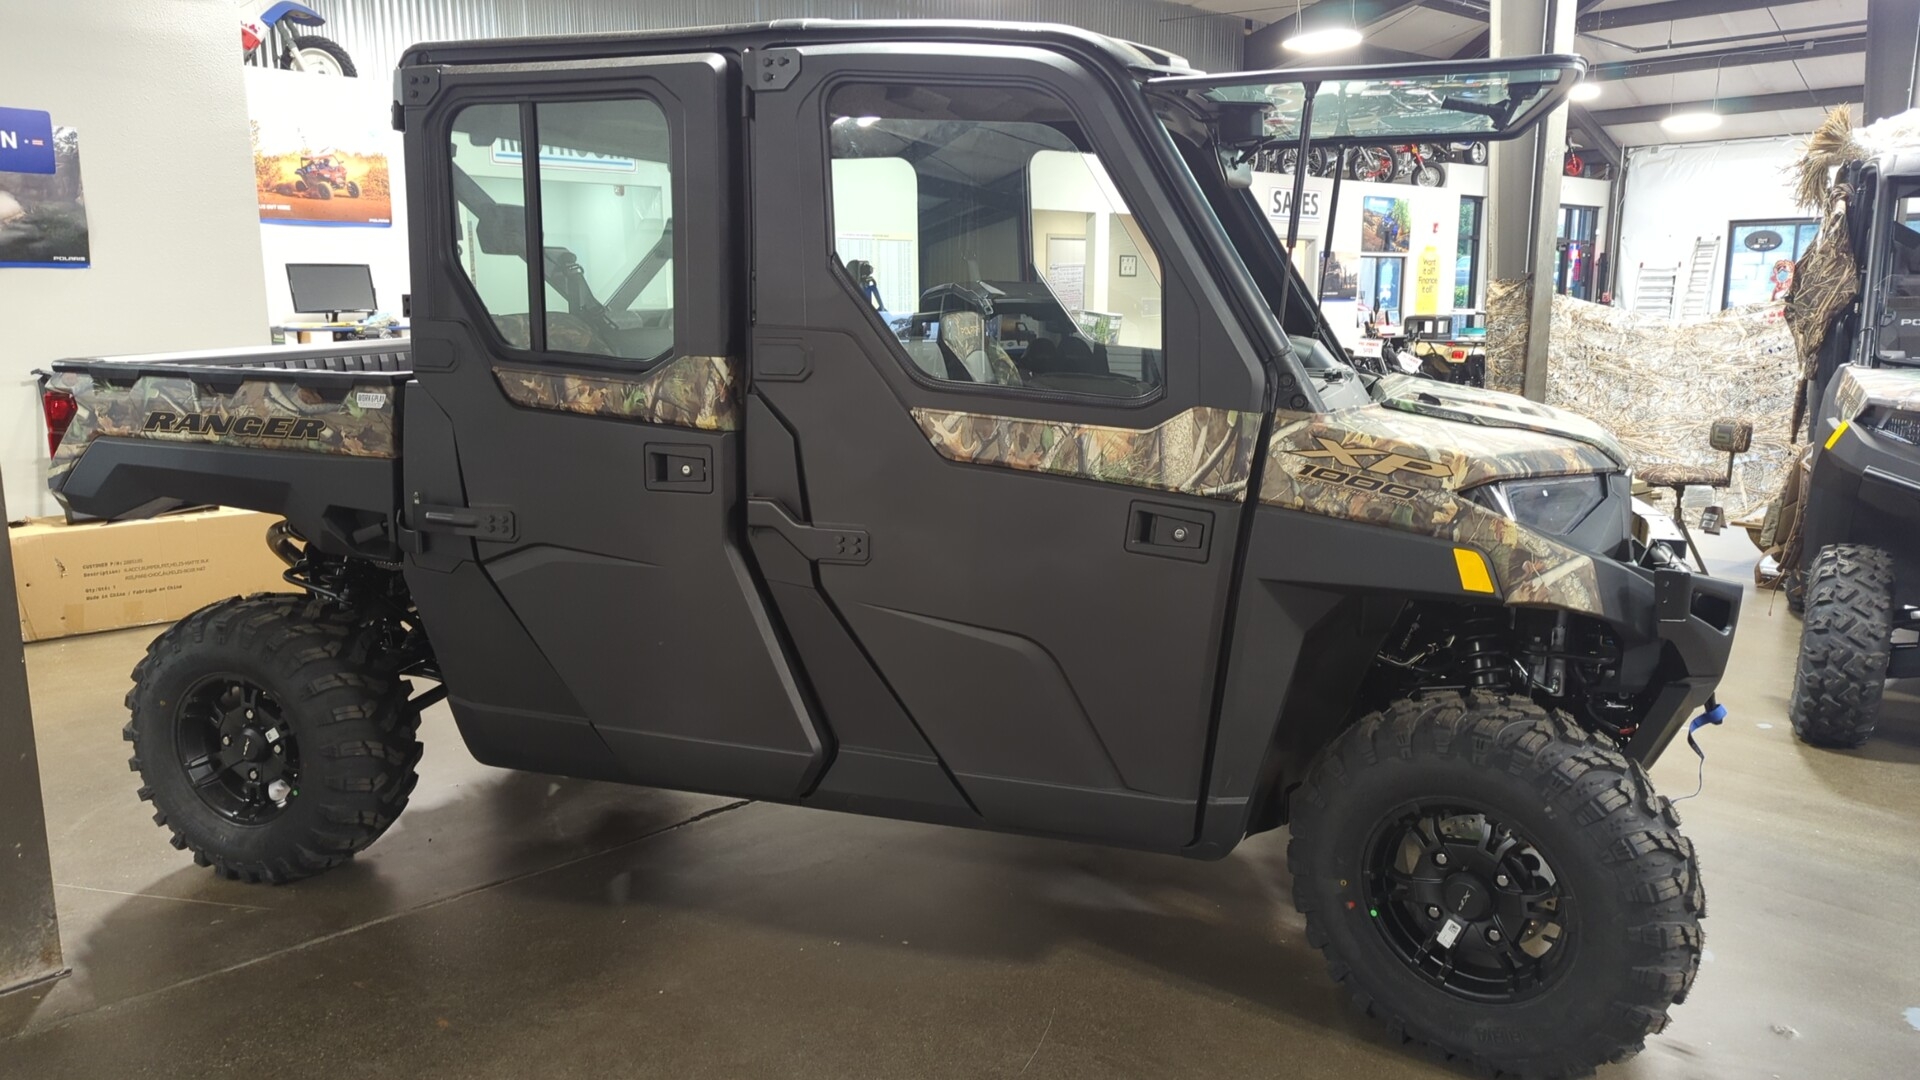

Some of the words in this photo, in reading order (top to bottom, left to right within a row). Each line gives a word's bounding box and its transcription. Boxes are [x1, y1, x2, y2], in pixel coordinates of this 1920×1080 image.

[1272, 190, 1319, 216] SAES
[142, 410, 327, 440] RANGER
[1284, 435, 1454, 479] XP
[1297, 463, 1421, 501] 1000
